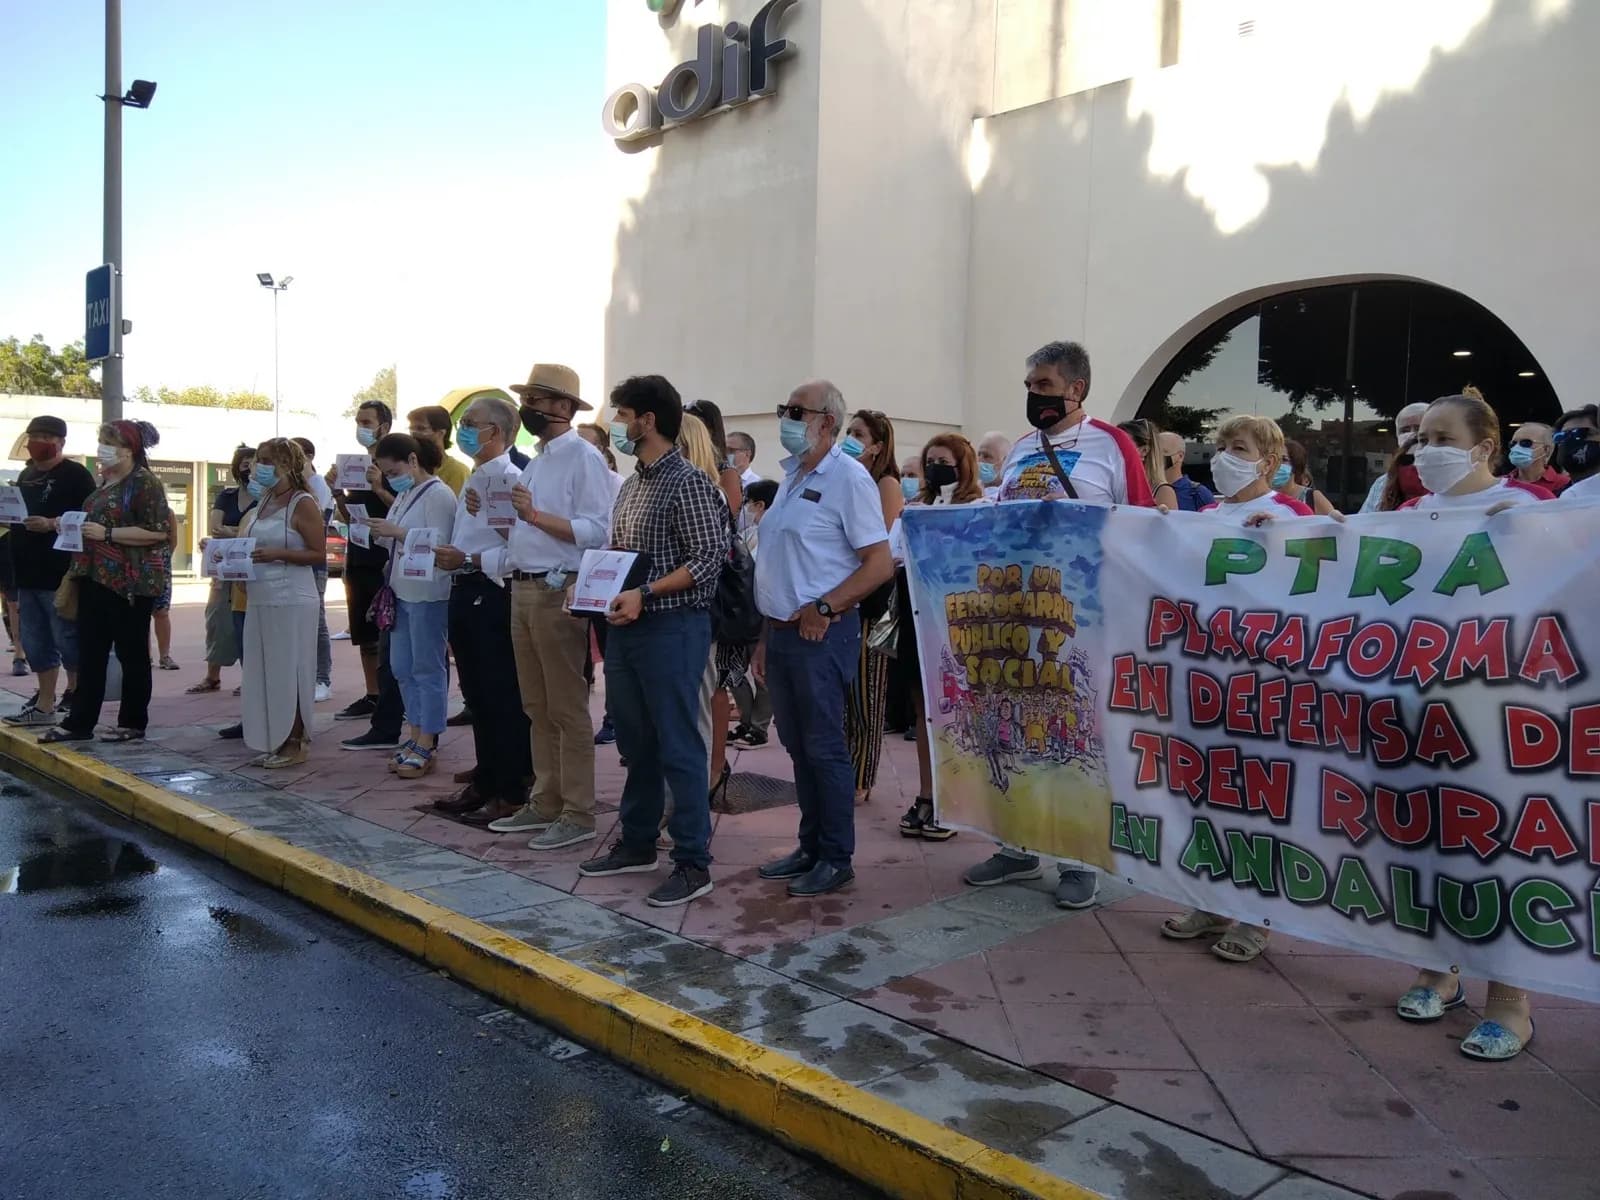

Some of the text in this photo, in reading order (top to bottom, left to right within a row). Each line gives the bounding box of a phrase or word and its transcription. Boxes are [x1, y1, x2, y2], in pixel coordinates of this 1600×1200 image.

[602, 0, 796, 138] adif
[86, 298, 110, 329] TAXI
[977, 563, 1061, 592] POR UN
[1204, 530, 1510, 606] PTRA
[965, 655, 1075, 693] SOCIAL
[1039, 627, 1066, 655] Y
[1147, 598, 1581, 687] PLATAFORMA
[1110, 654, 1169, 717] EN
[1189, 671, 1471, 764] DEFENSA
[1131, 731, 1292, 820] TREN
[1111, 804, 1159, 862] EN
